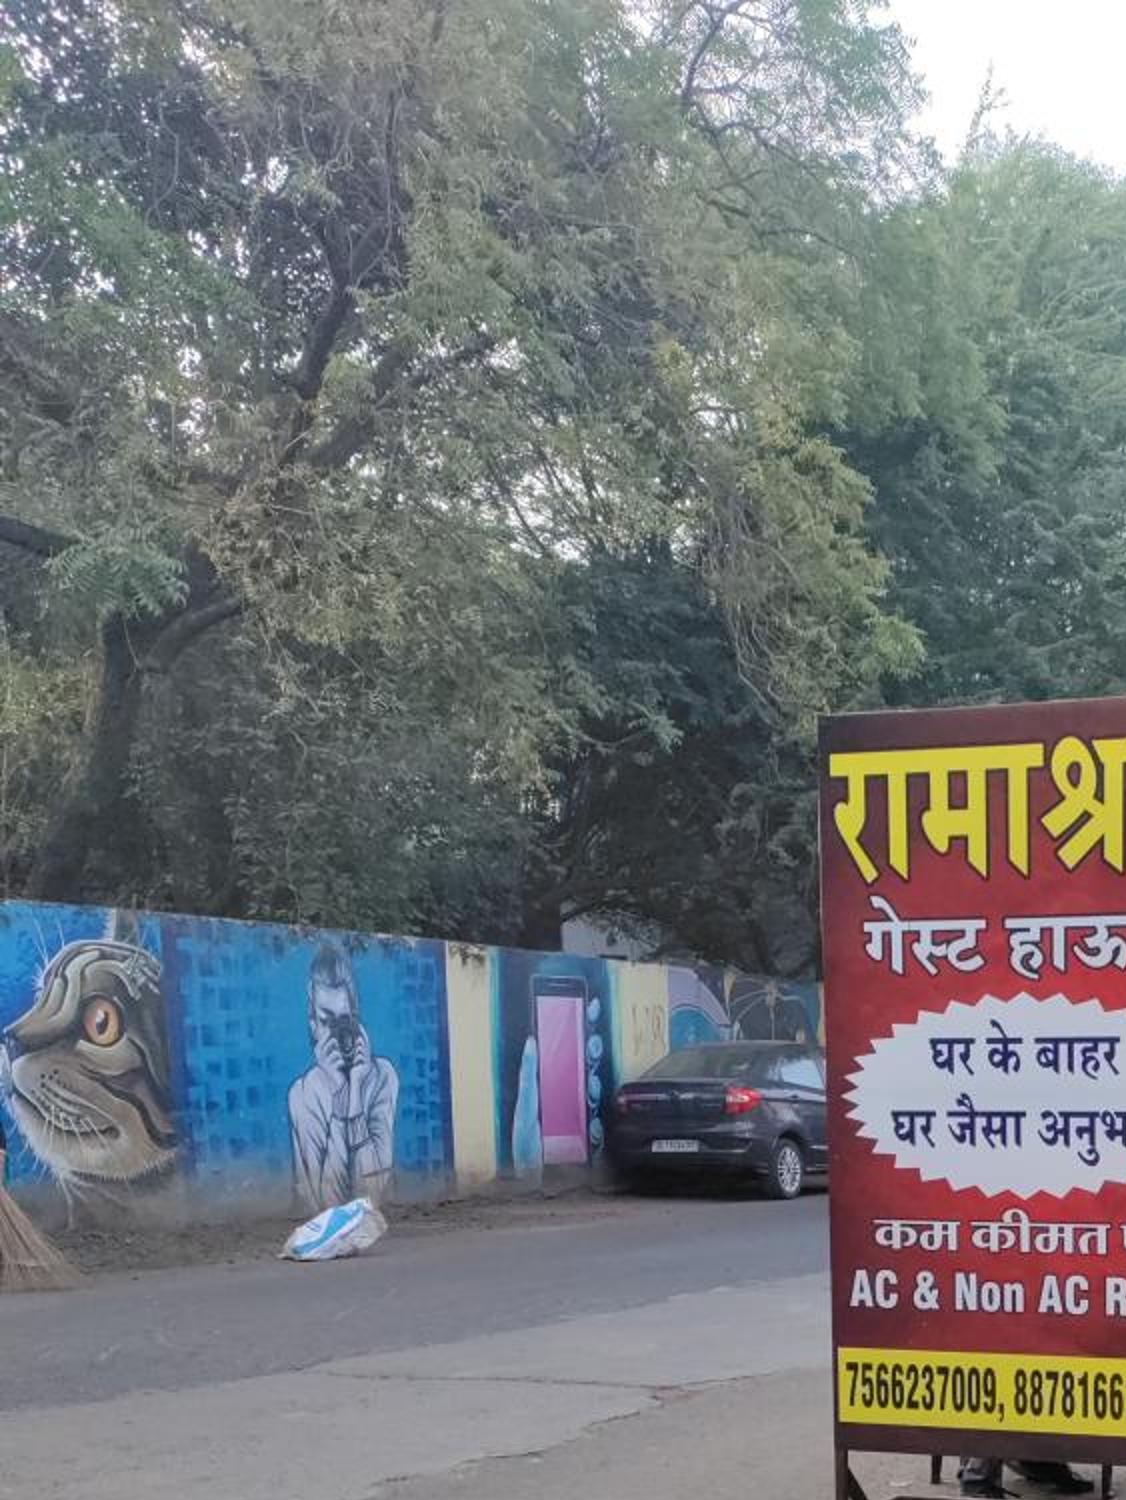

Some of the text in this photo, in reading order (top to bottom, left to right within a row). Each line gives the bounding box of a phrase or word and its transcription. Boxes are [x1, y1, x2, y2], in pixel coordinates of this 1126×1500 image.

[864, 895, 986, 978] गेस्ट
[930, 1020, 1121, 1080] घर के बाहर
[892, 1109, 937, 1147] घर
[947, 1092, 1027, 1149] जैसा
[873, 1217, 959, 1253] कम
[971, 1207, 1111, 1256] कीमत
[849, 1269, 899, 1309] AC
[913, 1270, 940, 1311] &
[954, 1272, 1024, 1314] Non
[1038, 1274, 1090, 1316] AC
[846, 1361, 1005, 1422] 7566237009,
